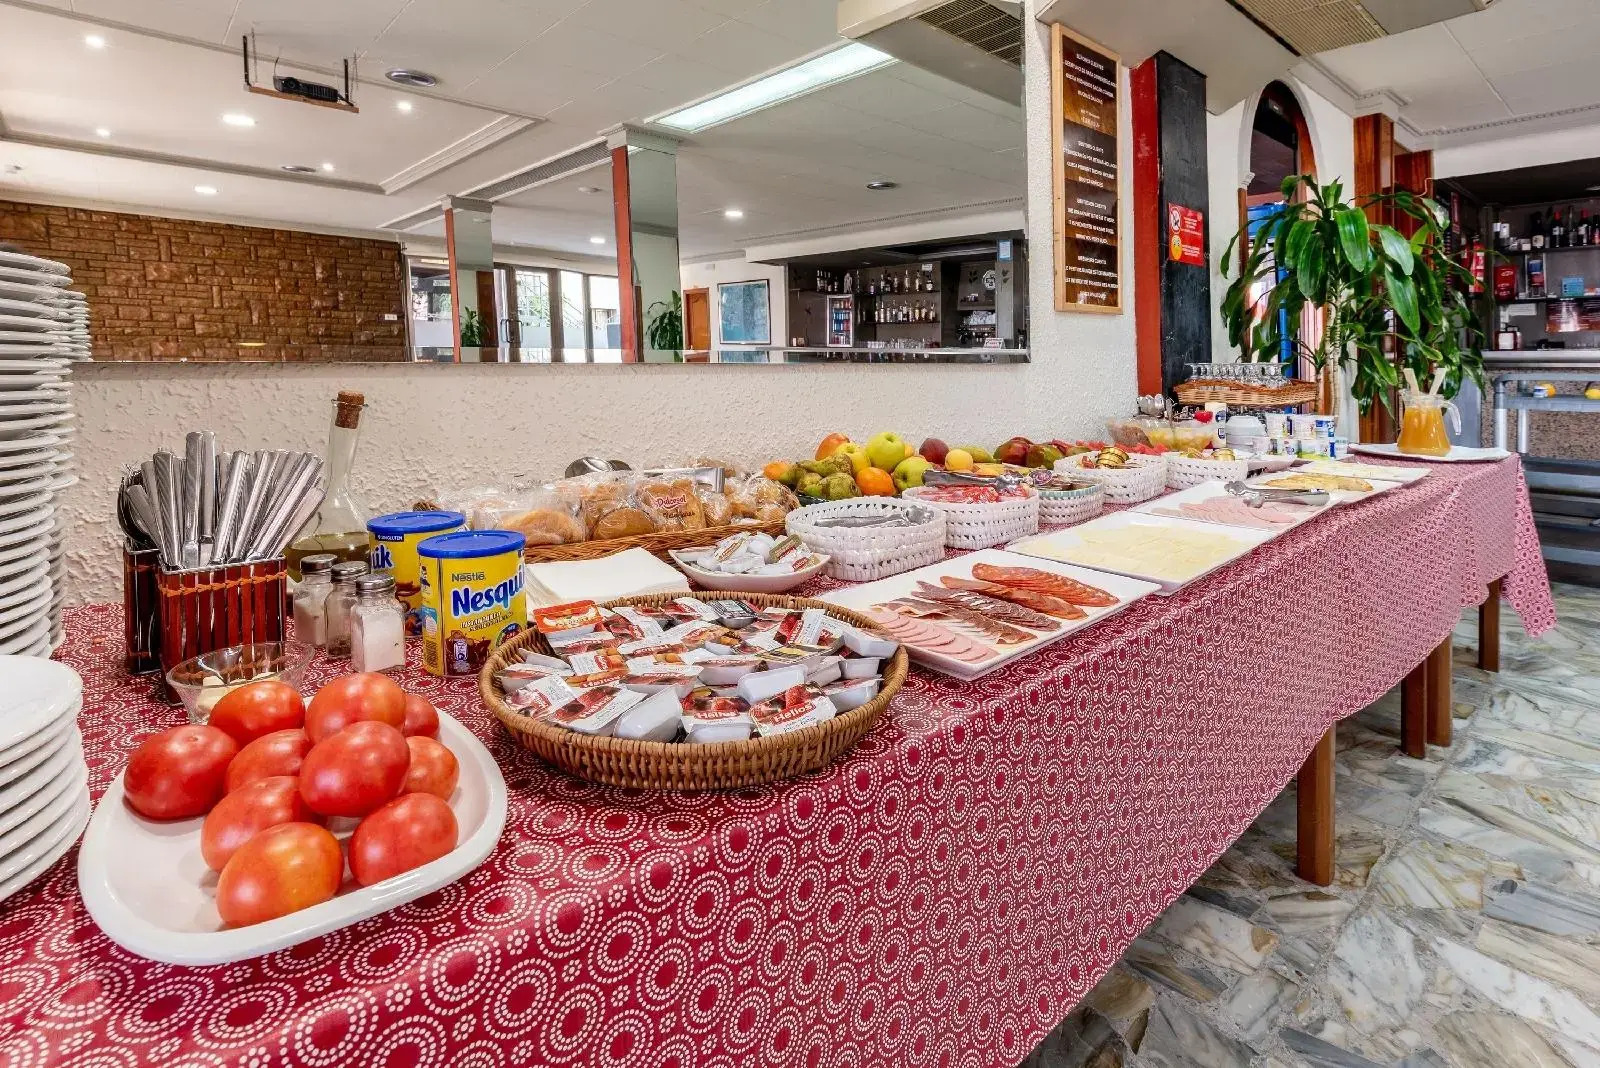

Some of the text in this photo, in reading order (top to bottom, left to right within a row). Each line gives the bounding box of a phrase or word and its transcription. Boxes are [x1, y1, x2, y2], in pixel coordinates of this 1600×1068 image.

[656, 495, 687, 508] Dulcosol
[451, 571, 487, 582] Nestlé
[773, 702, 813, 722] Helios
